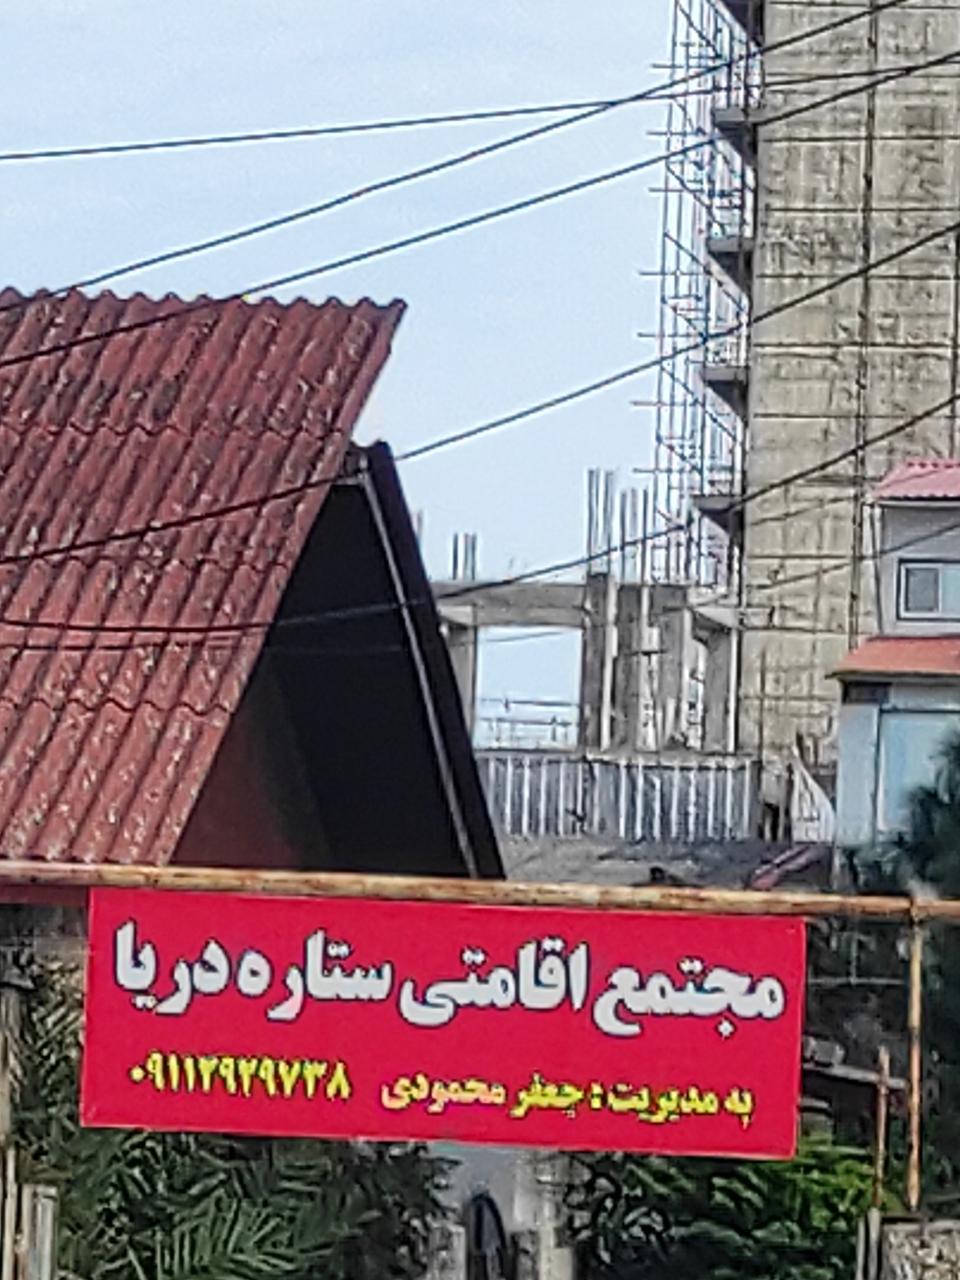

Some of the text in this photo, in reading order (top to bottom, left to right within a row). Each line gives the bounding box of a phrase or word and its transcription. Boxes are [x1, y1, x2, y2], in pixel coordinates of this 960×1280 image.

[115, 919, 786, 1037] مجتمع اقامتی ستاره دریا
[380, 1071, 507, 1113] محمودی
[509, 1072, 585, 1118] جعفر
[724, 1087, 754, 1130] به
